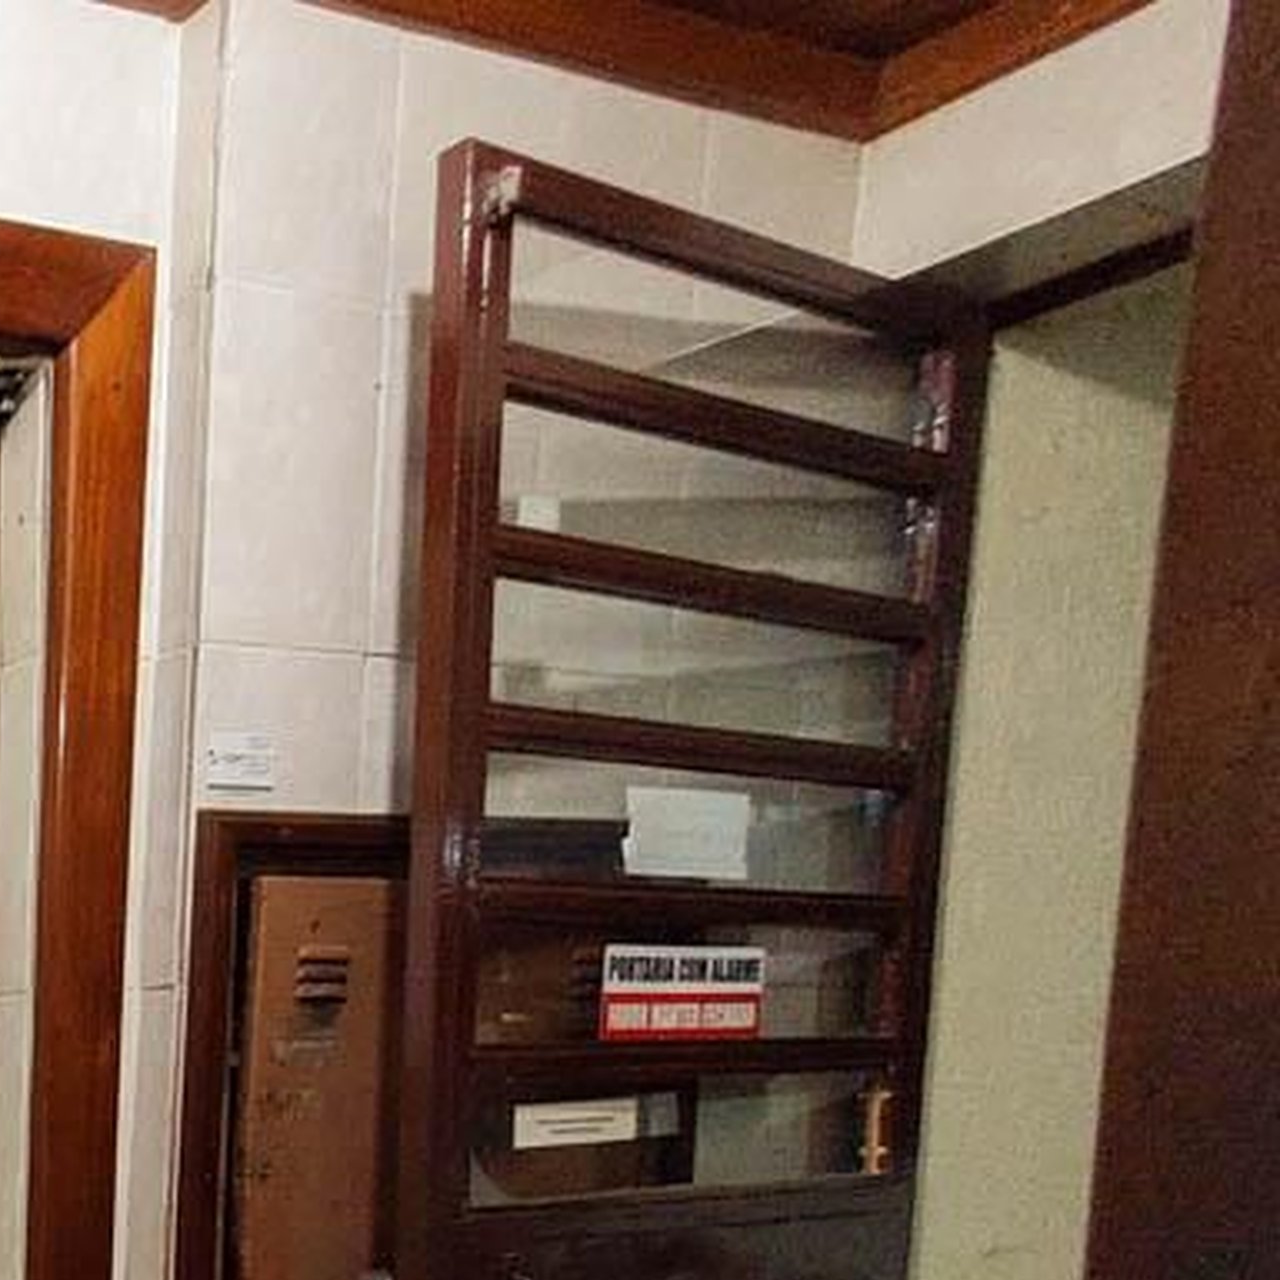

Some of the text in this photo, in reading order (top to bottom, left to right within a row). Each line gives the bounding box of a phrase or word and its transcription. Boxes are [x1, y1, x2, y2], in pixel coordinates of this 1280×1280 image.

[610, 955, 762, 983] PORTARIA COM ALARME
